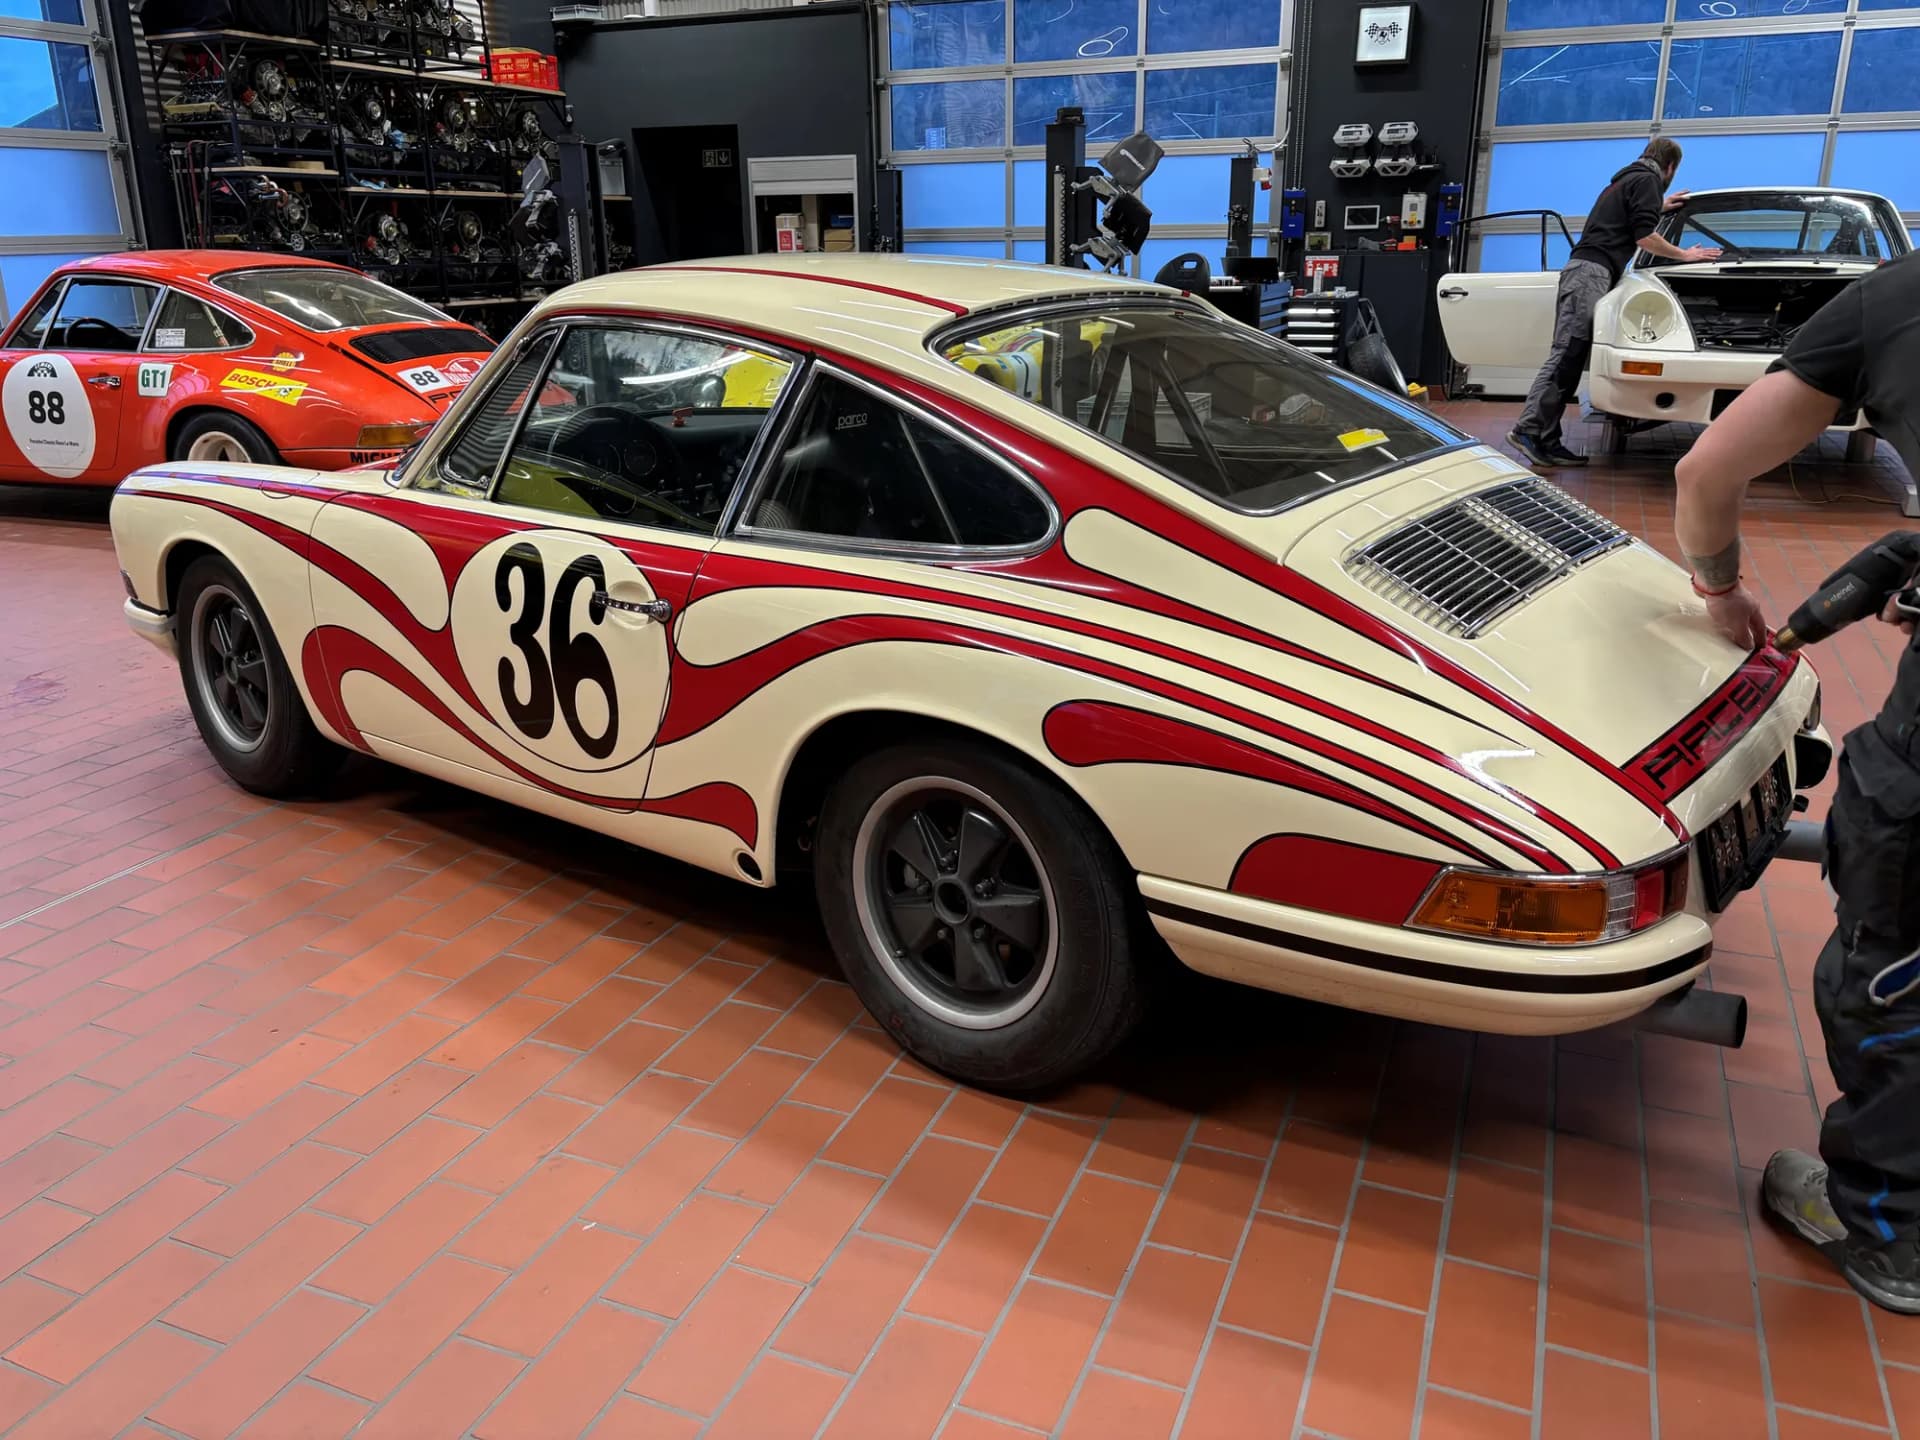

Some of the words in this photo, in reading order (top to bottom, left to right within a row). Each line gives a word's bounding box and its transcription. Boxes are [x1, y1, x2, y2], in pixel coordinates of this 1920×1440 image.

[141, 369, 166, 388] GT1
[229, 373, 277, 390] BOSCH
[410, 370, 440, 386] 88
[29, 390, 65, 425] 88
[495, 542, 619, 760] 36
